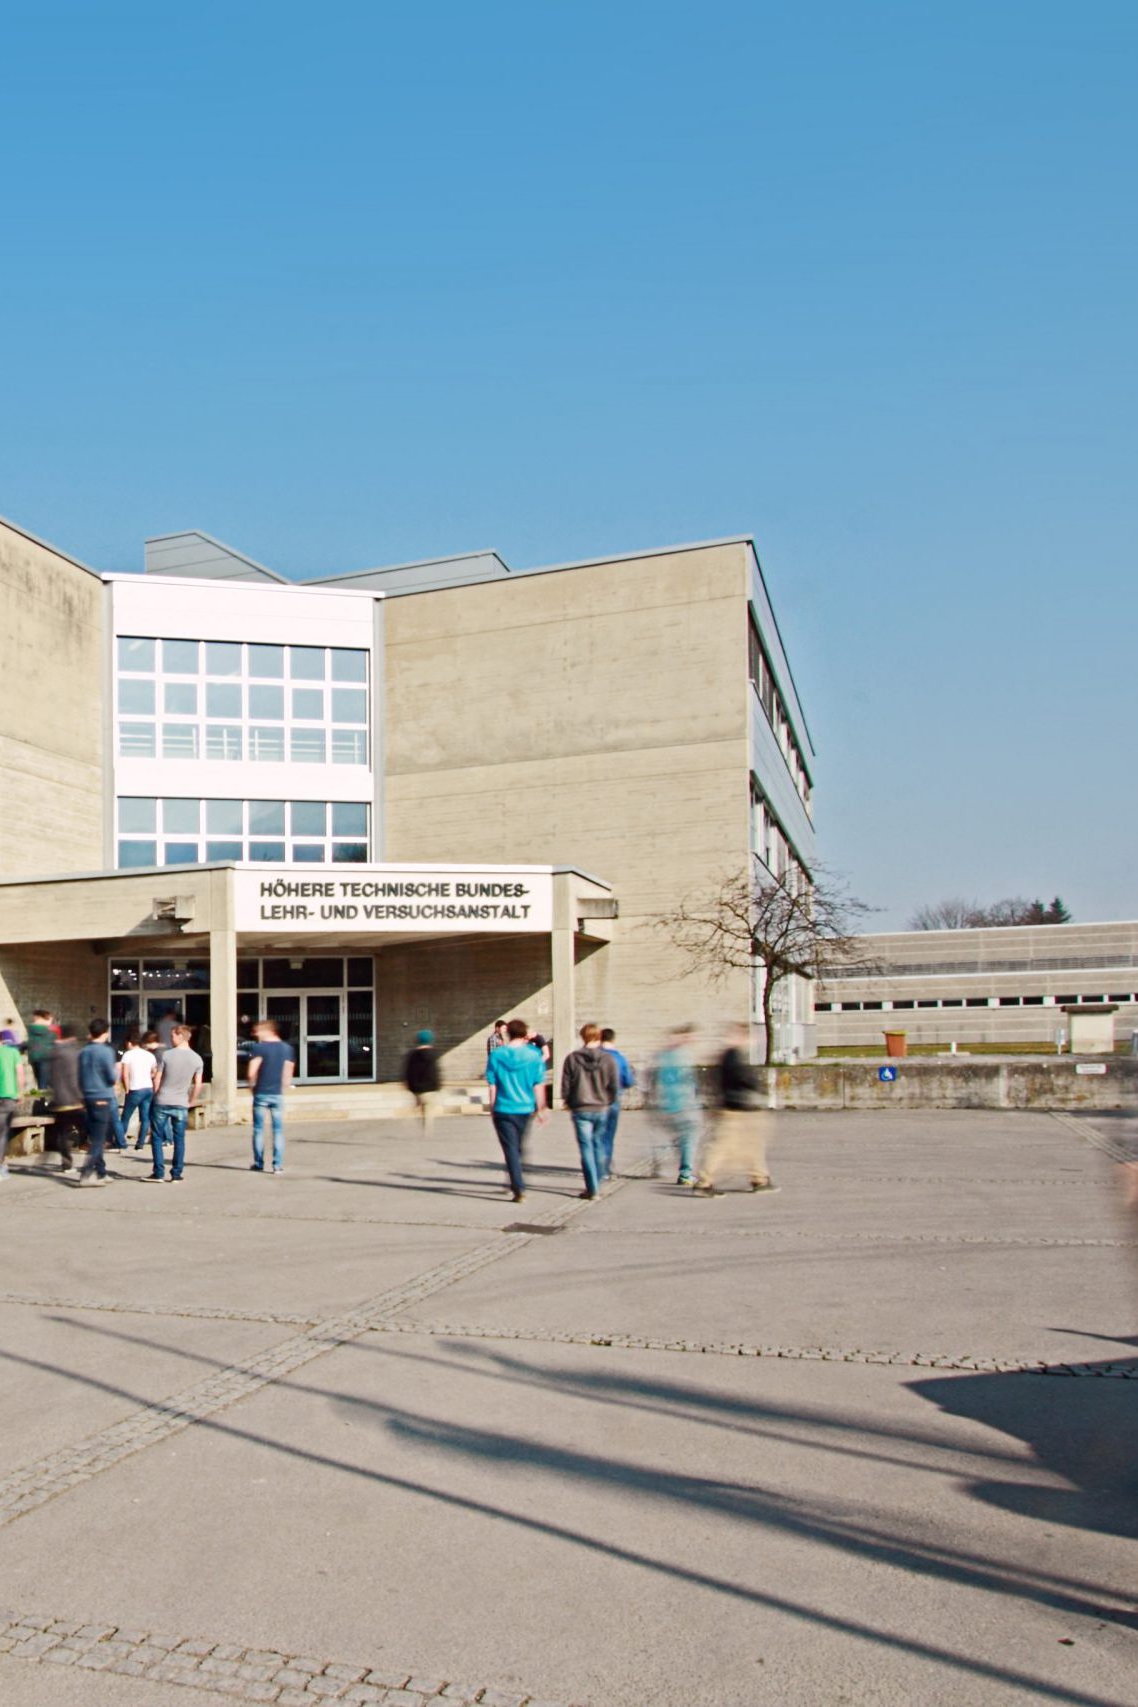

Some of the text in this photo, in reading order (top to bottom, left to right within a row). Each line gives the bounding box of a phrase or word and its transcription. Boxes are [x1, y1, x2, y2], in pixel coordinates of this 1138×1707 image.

[260, 879, 530, 898] HÖHERE TECHNISCHE BUNDES-
[260, 904, 531, 920] LEHR- UND VERSUCHSANSTALT
